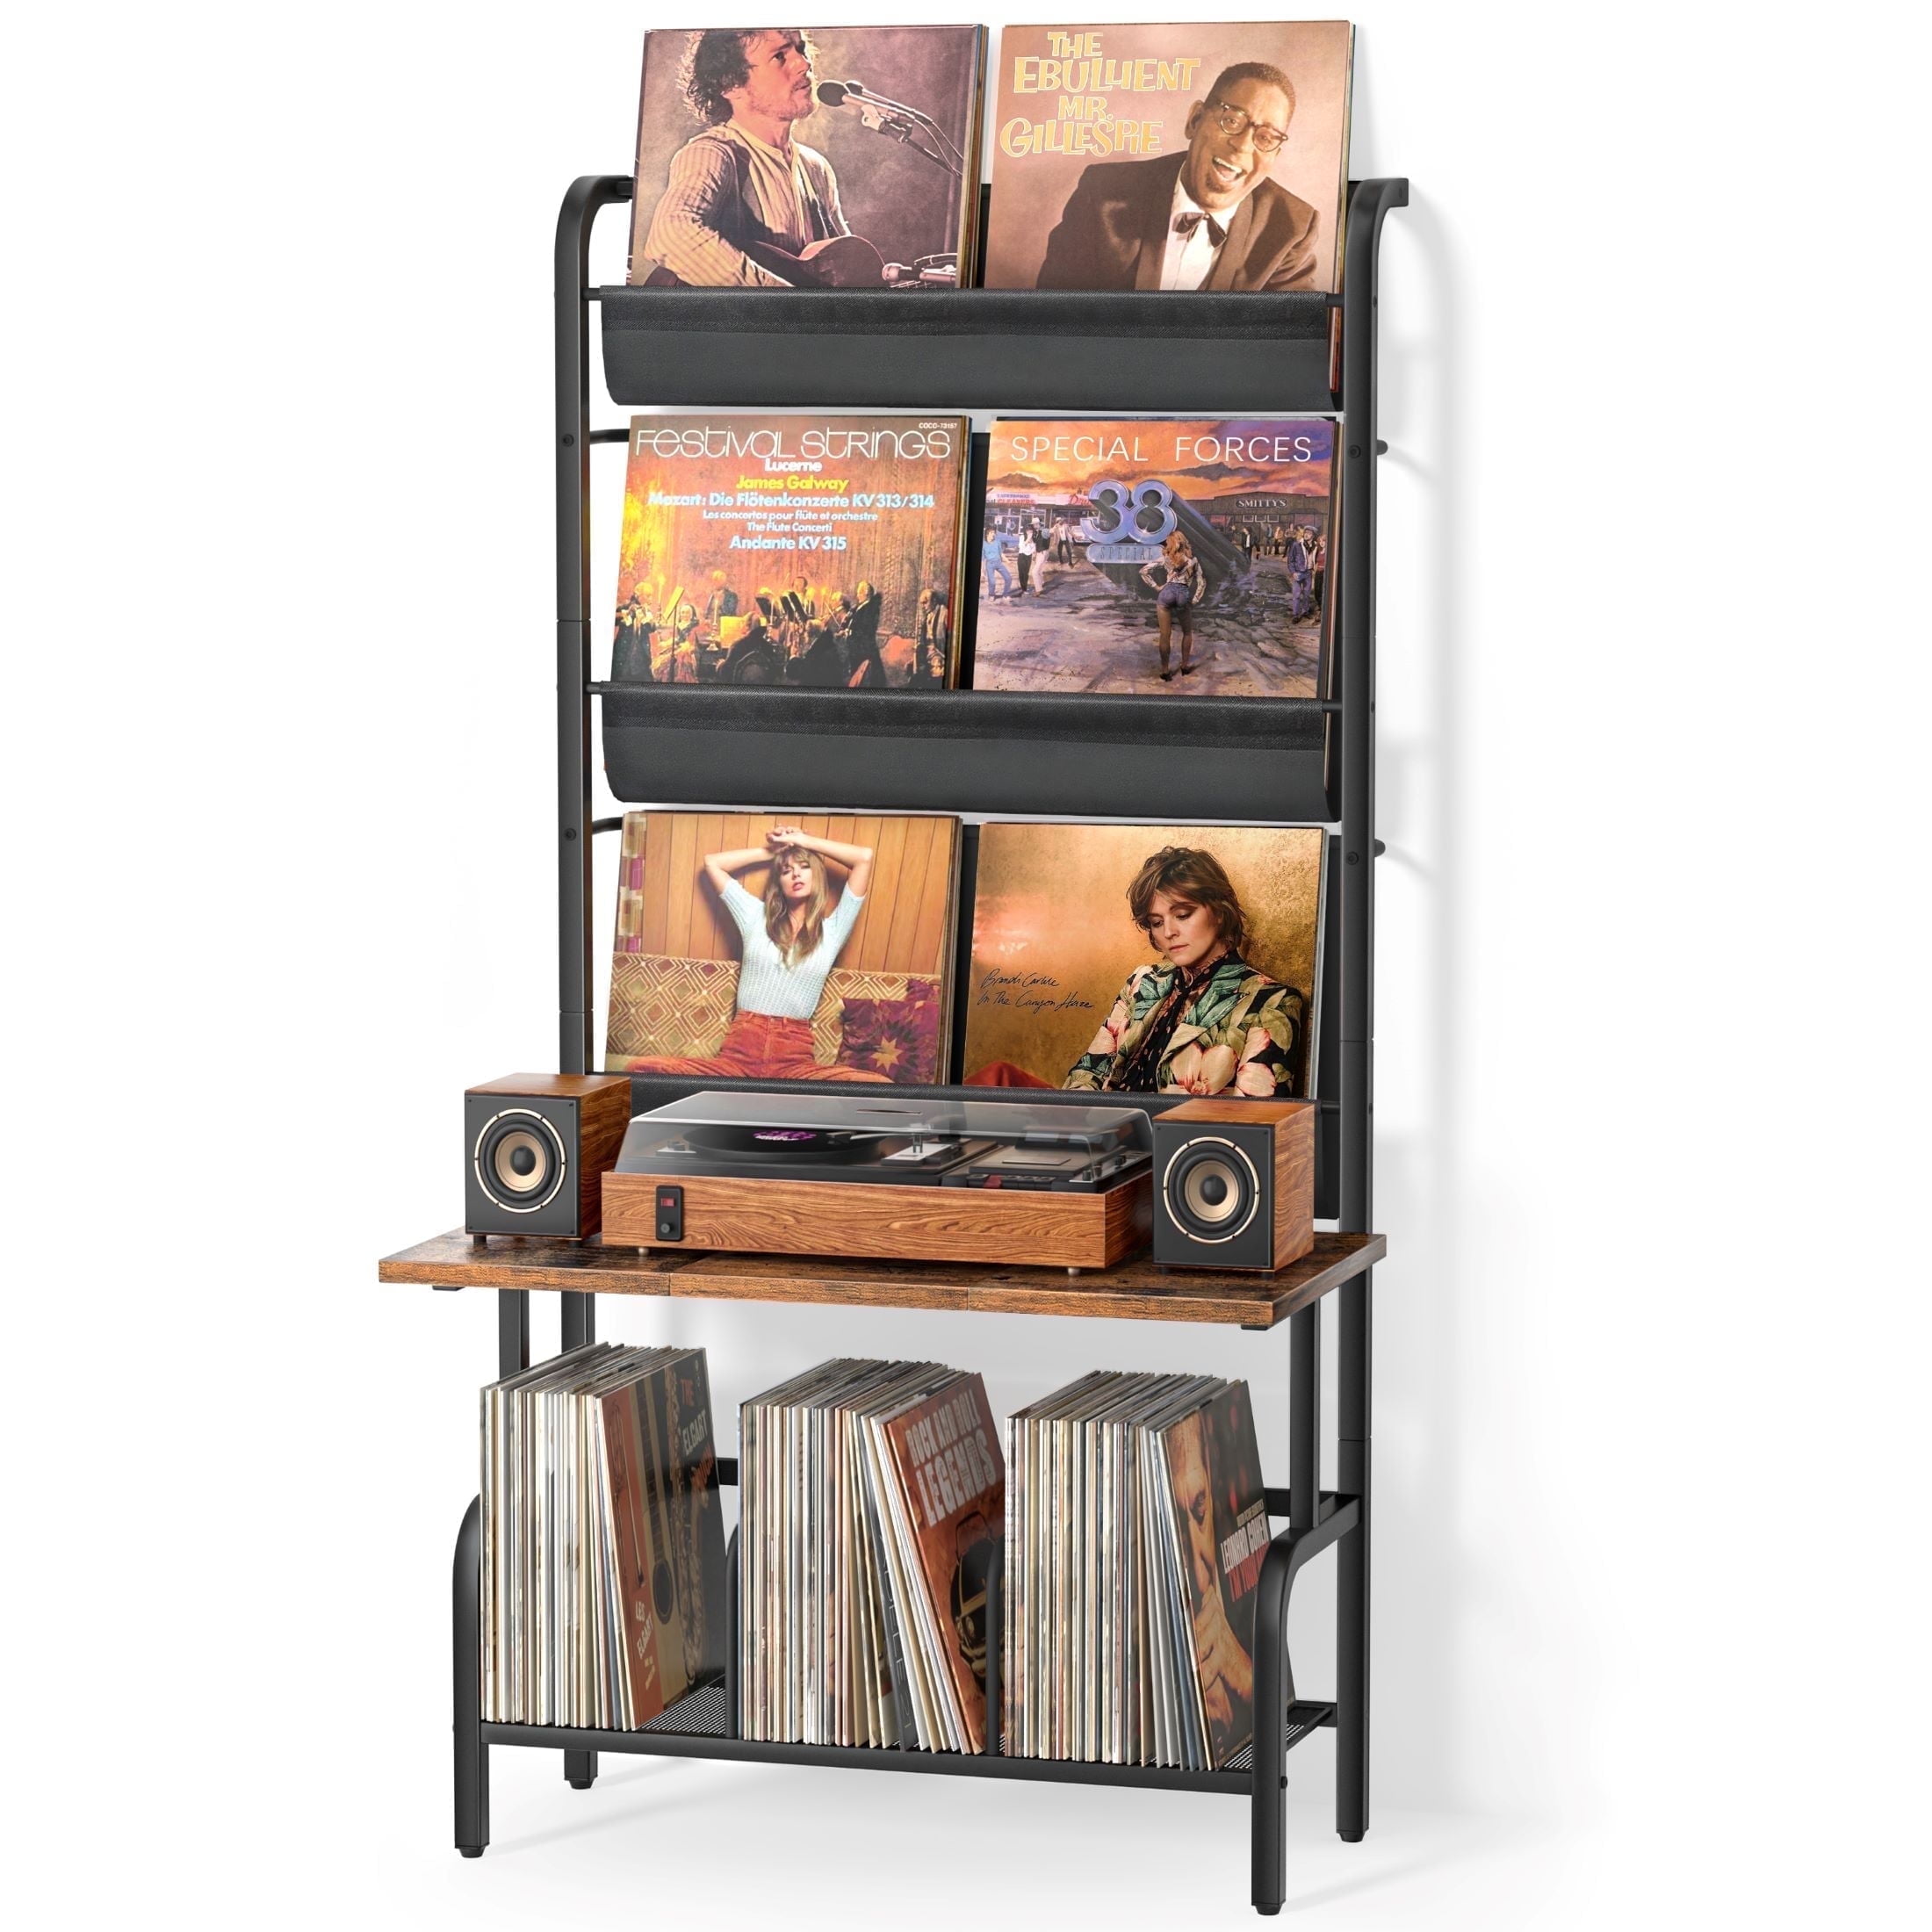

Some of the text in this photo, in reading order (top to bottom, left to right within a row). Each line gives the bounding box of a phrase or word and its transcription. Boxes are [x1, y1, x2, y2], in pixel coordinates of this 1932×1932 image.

[1048, 32, 1103, 58] THE
[1013, 56, 1201, 93] EBULLIENT
[1057, 96, 1114, 120] MR.
[1000, 118, 1163, 157] GILLESPIE
[1011, 436, 1311, 462] SPECIAL FORCES
[765, 458, 823, 472] Lucerne
[736, 474, 849, 493] James Galway
[710, 493, 733, 506] Die
[737, 492, 849, 507] Flötenkonzerte
[853, 494, 874, 507] KV
[1237, 499, 1287, 508] SMITTY'S
[703, 509, 718, 519] Les
[720, 510, 768, 520] concertos
[769, 511, 794, 524] pour
[819, 511, 830, 520] et
[831, 510, 878, 521] orchestre
[1080, 479, 1178, 545] 38
[747, 522, 833, 532] The Flute Concerti
[729, 535, 847, 550] Andante KV 315
[1099, 546, 1154, 561] SPECIAL
[992, 991, 1011, 1006] The
[682, 1409, 708, 1457] ELGART
[905, 1388, 982, 1467] ROCK AND ROLL
[915, 1428, 997, 1528] LEGENDS
[635, 1601, 645, 1623] LES
[637, 1611, 653, 1660] ELGART
